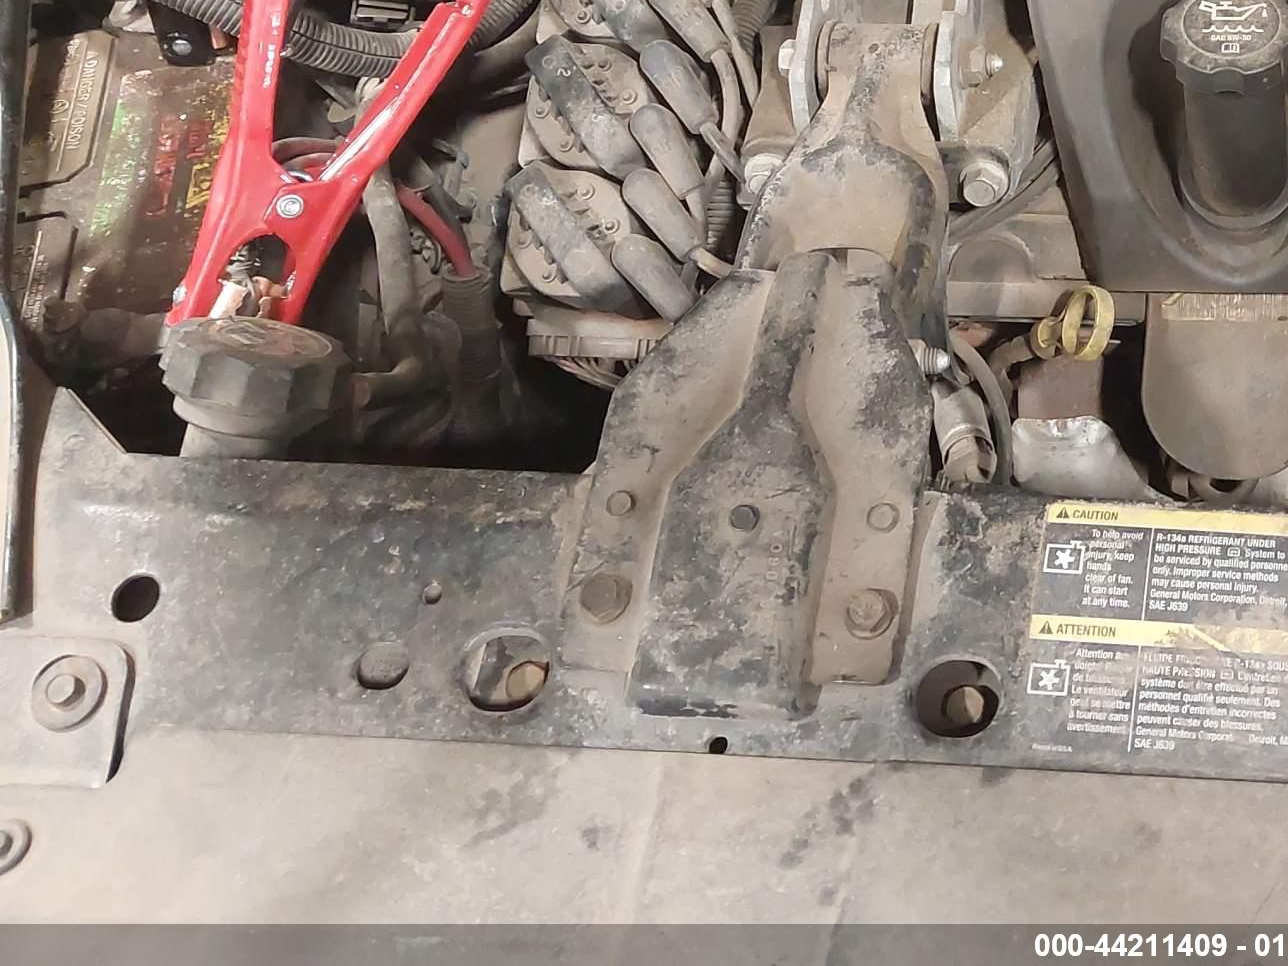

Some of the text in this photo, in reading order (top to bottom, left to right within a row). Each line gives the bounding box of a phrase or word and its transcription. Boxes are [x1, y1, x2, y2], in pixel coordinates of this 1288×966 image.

[1073, 510, 1118, 521] CAUTION
[1092, 529, 1144, 540] To help avoid
[1090, 540, 1124, 549] personal
[1157, 533, 1276, 549] R-134a REFRIGERANT UNDER
[1114, 552, 1134, 562] keep
[1155, 543, 1286, 560] HIGH PRESSURE System to
[1087, 562, 1111, 571] hands
[1153, 554, 1164, 563] be
[1166, 555, 1201, 565] serviced
[1202, 557, 1212, 568] by
[1214, 558, 1249, 569] qualified
[1085, 574, 1133, 584] clear of fan.
[1152, 565, 1279, 582] only. Improper service methods
[1084, 584, 1128, 595] It can start
[1151, 578, 1232, 591] may cause personal
[1150, 589, 1208, 601] General Motors
[1082, 597, 1130, 608] at any time.
[1149, 600, 1189, 611] SAE J639
[1056, 623, 1117, 638] ATTENTION
[1076, 648, 1114, 659] Attention
[1140, 678, 1176, 689] système
[1139, 690, 1181, 701] personnel
[1182, 693, 1214, 703] qualifié
[1264, 697, 1280, 708] Des
[1138, 702, 1180, 713] méthodes
[1181, 704, 1227, 716] d'entretien
[1076, 710, 1129, 722] tourner sans
[1137, 715, 1171, 725] peuvent
[1203, 719, 1219, 728] des
[1136, 726, 1167, 737] General
[1168, 728, 1196, 739] Motors
[1134, 738, 1175, 750] SAE J639
